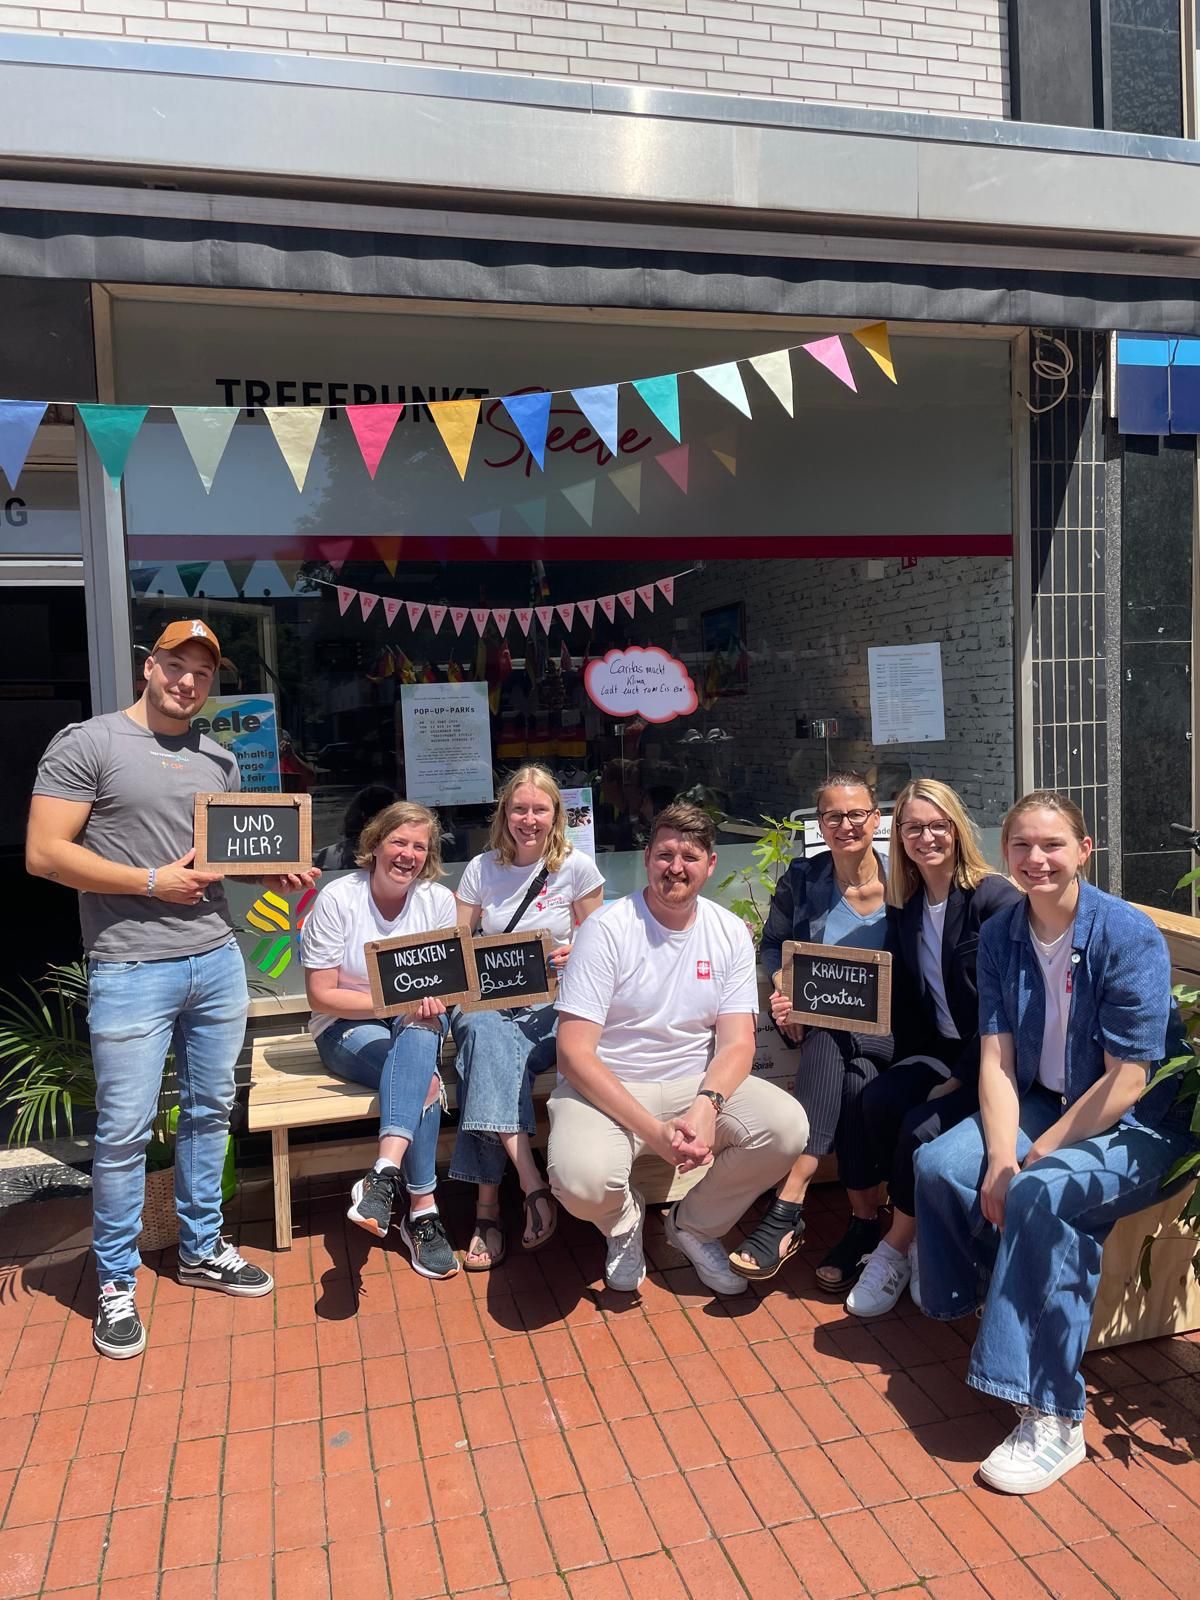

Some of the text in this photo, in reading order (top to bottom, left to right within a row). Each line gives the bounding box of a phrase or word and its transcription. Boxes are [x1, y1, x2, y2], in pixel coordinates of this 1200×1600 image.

[484, 386, 652, 478] Seee
[4, 497, 28, 527] G
[191, 620, 207, 636] LA
[610, 659, 665, 675] Caritas macht
[414, 706, 475, 715] POP-UP-PARKs
[191, 711, 261, 734] eele
[233, 814, 275, 833] UND
[227, 835, 283, 857] HIER?
[394, 972, 443, 992] Oase
[480, 971, 528, 994] Beet
[811, 961, 875, 985] KRÄUTER-
[803, 981, 866, 1011] Garten
